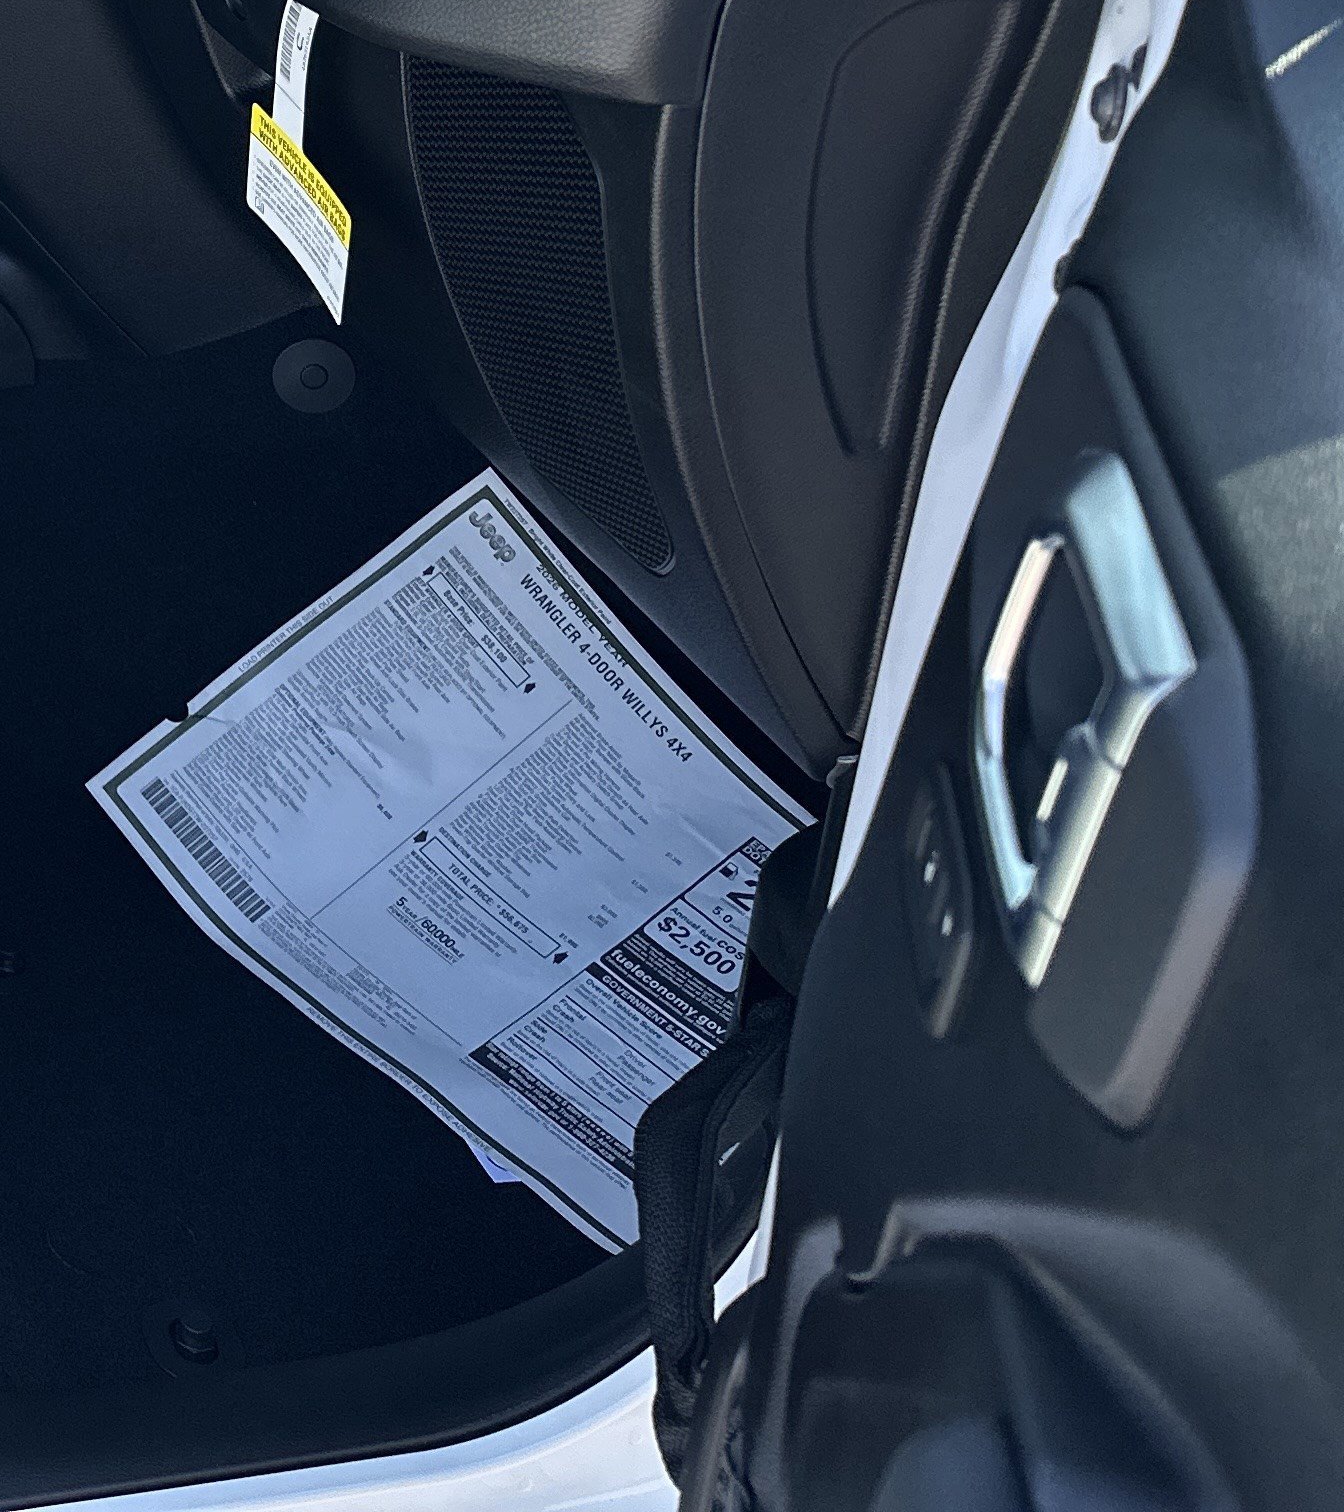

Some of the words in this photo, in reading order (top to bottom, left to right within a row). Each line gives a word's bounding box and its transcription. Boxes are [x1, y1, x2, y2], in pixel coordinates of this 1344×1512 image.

[258, 113, 276, 142] THIS
[276, 134, 307, 176] VEHICLE
[258, 125, 278, 156] WITH
[278, 148, 317, 200] ADVANCED
[468, 510, 517, 564] Jeep
[441, 588, 461, 609] Base
[455, 604, 476, 627] Price:
[560, 591, 597, 632] MODEL
[599, 637, 628, 668] YEAR
[520, 574, 581, 644] WRANGLER
[576, 637, 625, 693] 4-DOOR
[620, 686, 670, 741] WILLYS
[663, 731, 694, 766] 4X4
[447, 862, 472, 886] TOTAL
[468, 881, 495, 907] PRICE:
[386, 903, 426, 939] POWERTRAIN
[423, 935, 457, 966] WARRANTY
[657, 915, 736, 975] $2,500
[671, 908, 699, 930] Annual
[557, 995, 587, 1023] Frontal
[584, 975, 613, 1002] Overall
[600, 972, 668, 1029] GOVERNMENT
[664, 1021, 700, 1052] 5-STAR
[611, 949, 727, 1036] fueleconomy.gov
